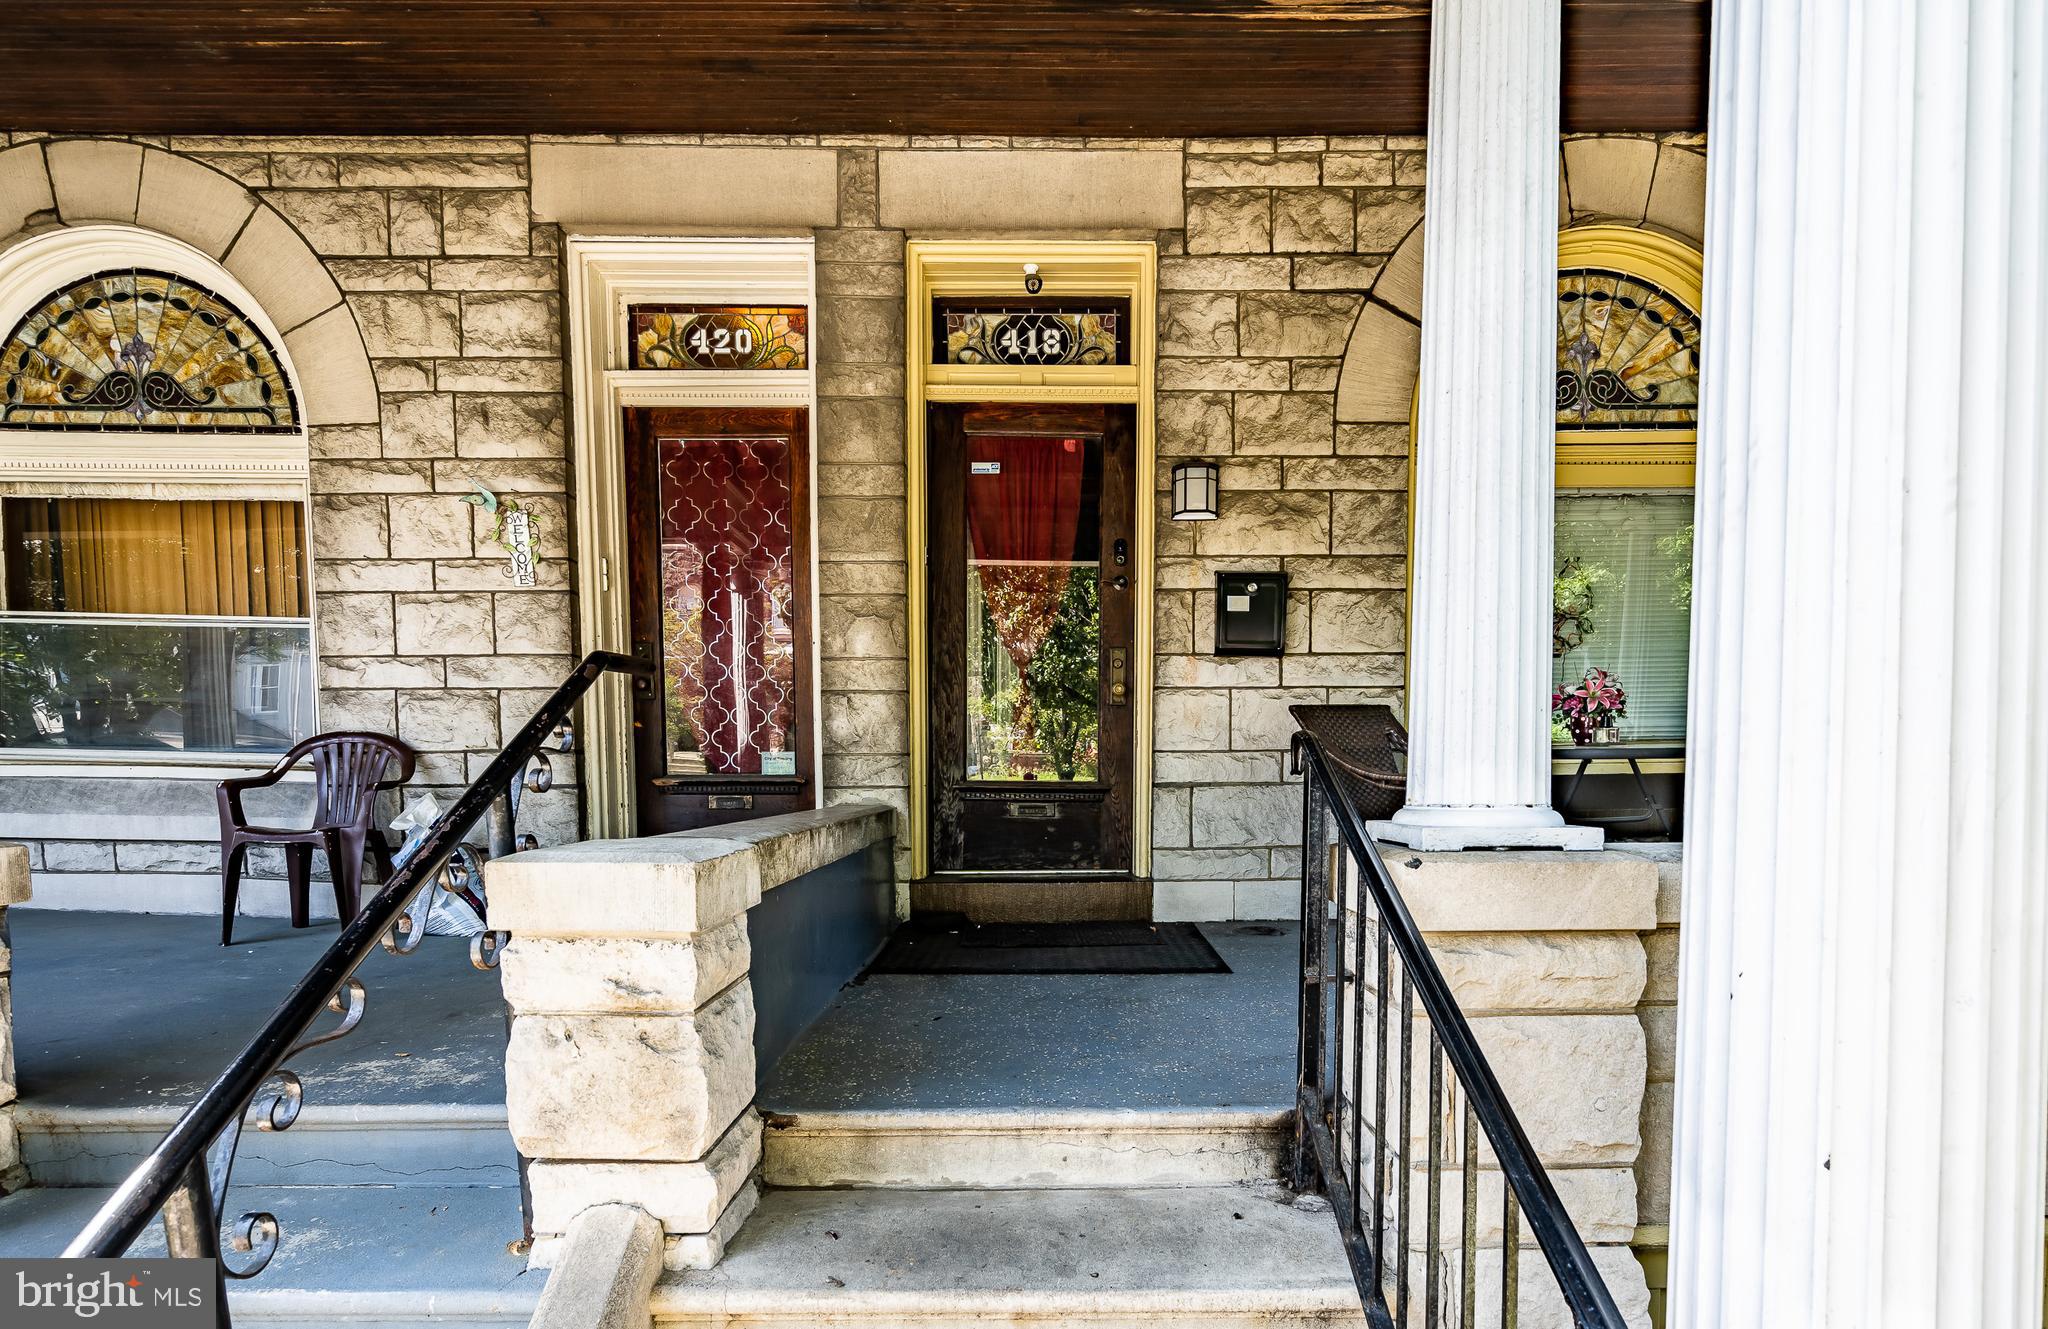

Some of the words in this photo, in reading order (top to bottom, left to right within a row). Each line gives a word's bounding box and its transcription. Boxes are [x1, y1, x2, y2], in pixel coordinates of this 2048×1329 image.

[691, 329, 752, 354] 420
[1000, 329, 1060, 354] 418
[513, 514, 529, 584] WELCOME
